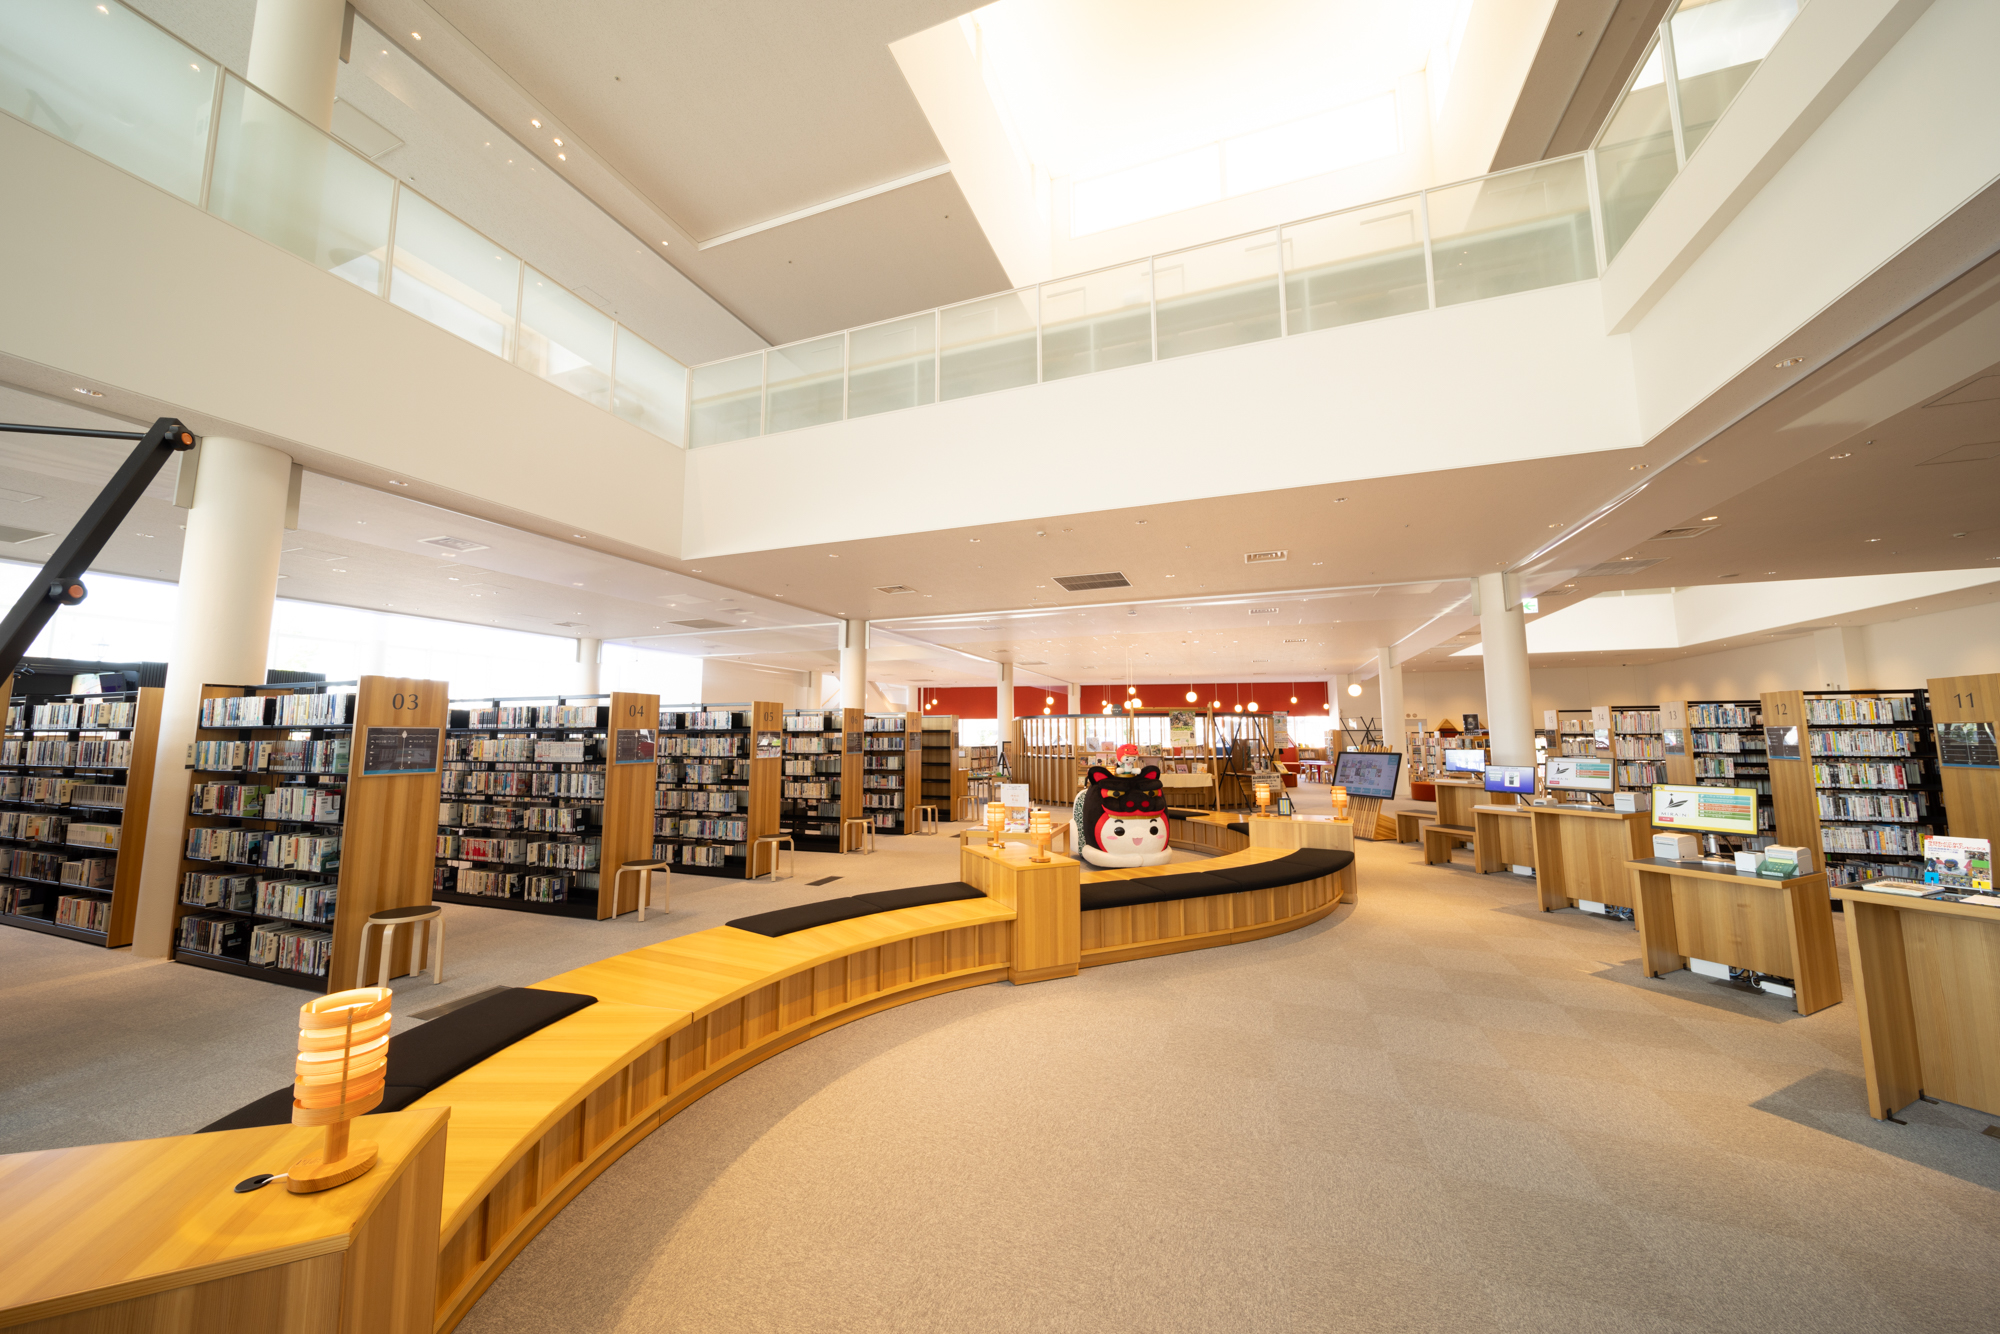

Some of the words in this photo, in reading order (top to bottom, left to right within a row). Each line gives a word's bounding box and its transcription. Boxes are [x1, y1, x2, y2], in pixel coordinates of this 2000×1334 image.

[392, 693, 419, 710] 03
[1953, 692, 1974, 708] 11
[629, 704, 644, 717] 04
[1668, 710, 1678, 720] 13
[1774, 703, 1788, 715] 12
[763, 711, 774, 722] 05
[1597, 713, 1605, 721] 14
